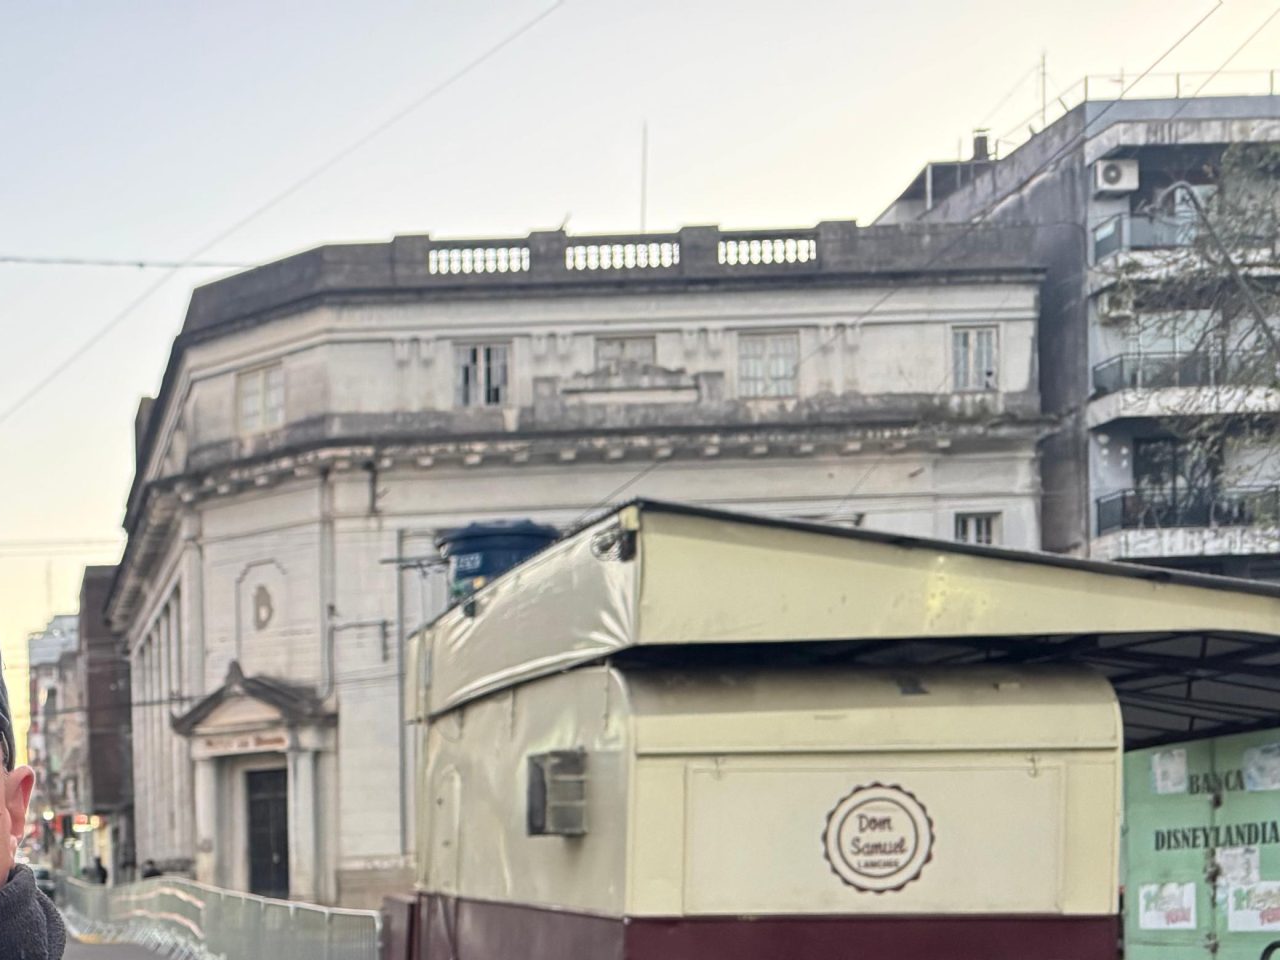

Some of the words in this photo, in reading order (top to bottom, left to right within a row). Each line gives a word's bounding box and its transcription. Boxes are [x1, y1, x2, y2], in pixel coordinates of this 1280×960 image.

[1188, 769, 1246, 795] BANCA
[850, 836, 908, 856] Samuel
[1154, 821, 1280, 851] DISNEYLANDIA
